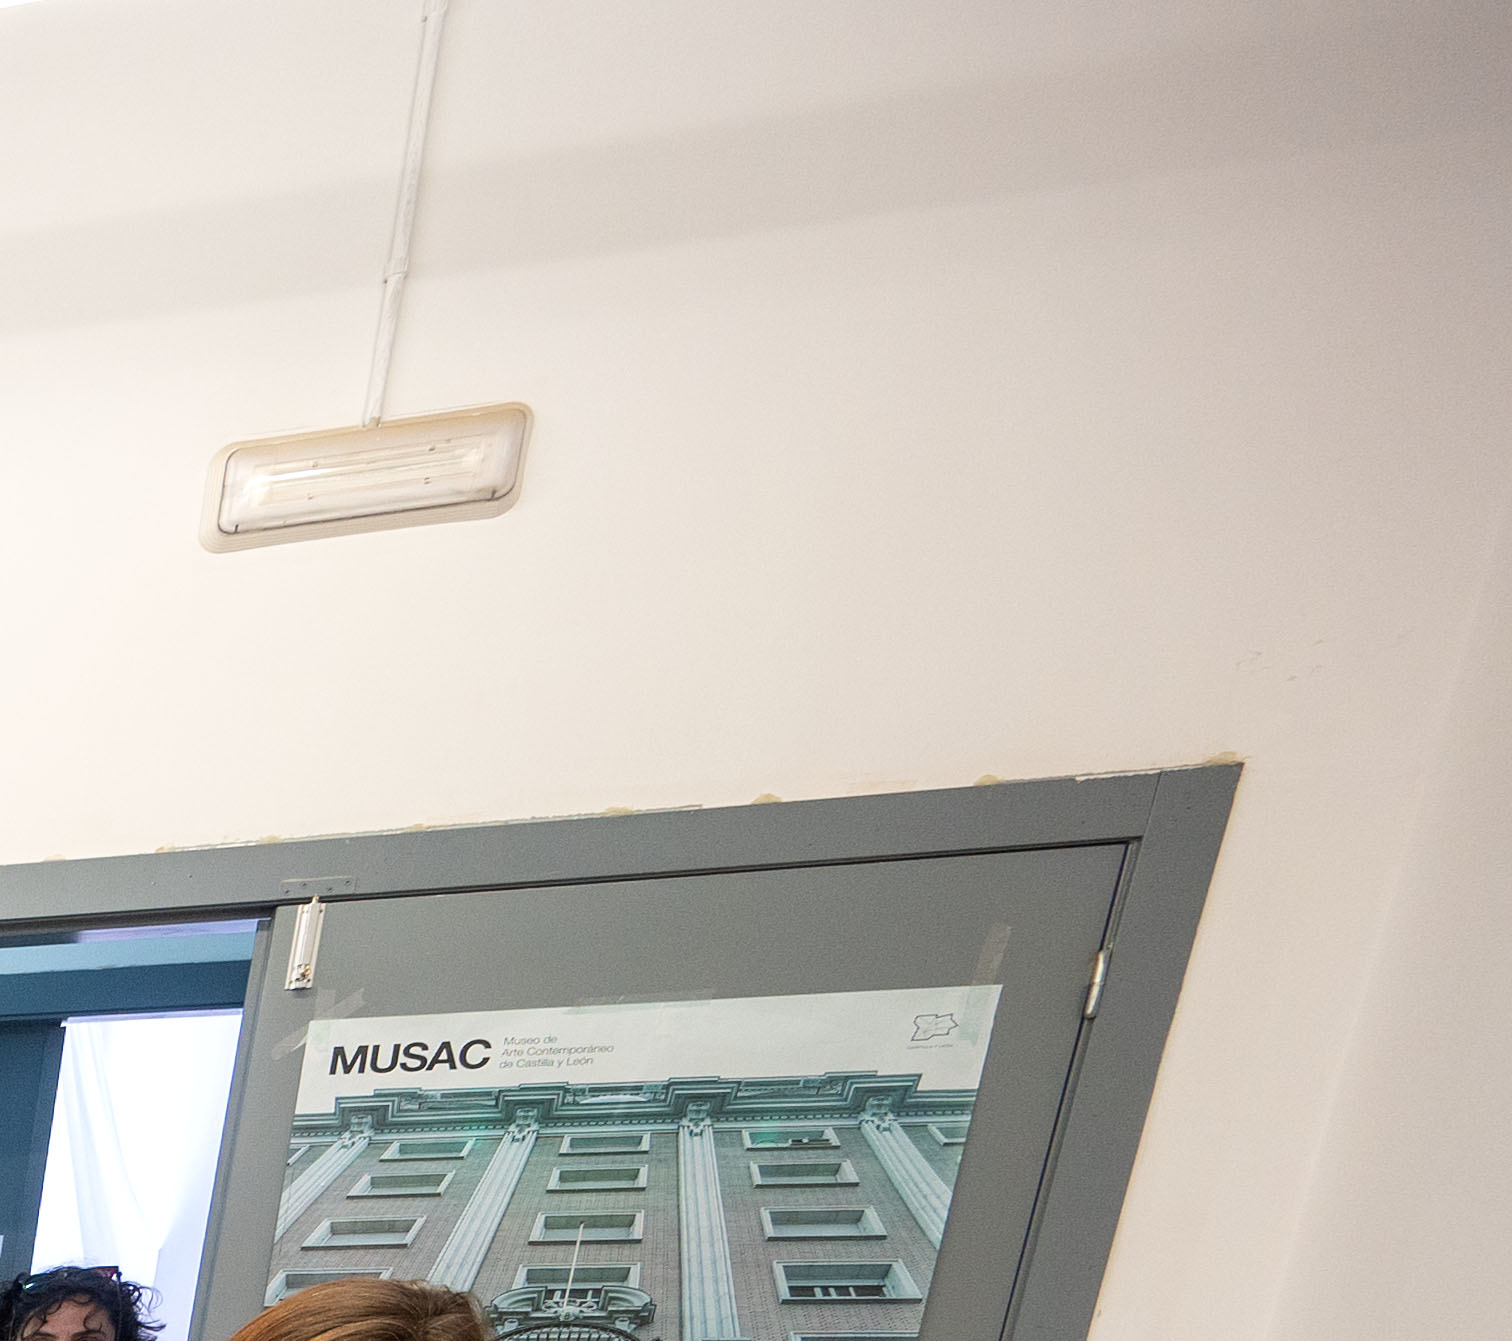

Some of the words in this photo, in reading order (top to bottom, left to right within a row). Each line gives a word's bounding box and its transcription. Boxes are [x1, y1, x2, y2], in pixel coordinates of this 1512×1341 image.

[503, 1036, 541, 1046] Museo
[543, 1035, 558, 1044] de
[328, 1038, 492, 1076] MUSAC
[501, 1048, 524, 1057] Arte
[526, 1044, 615, 1056] Contemporáneo
[498, 1060, 514, 1069] de
[516, 1057, 554, 1068] Castilla
[566, 1056, 594, 1066] León
